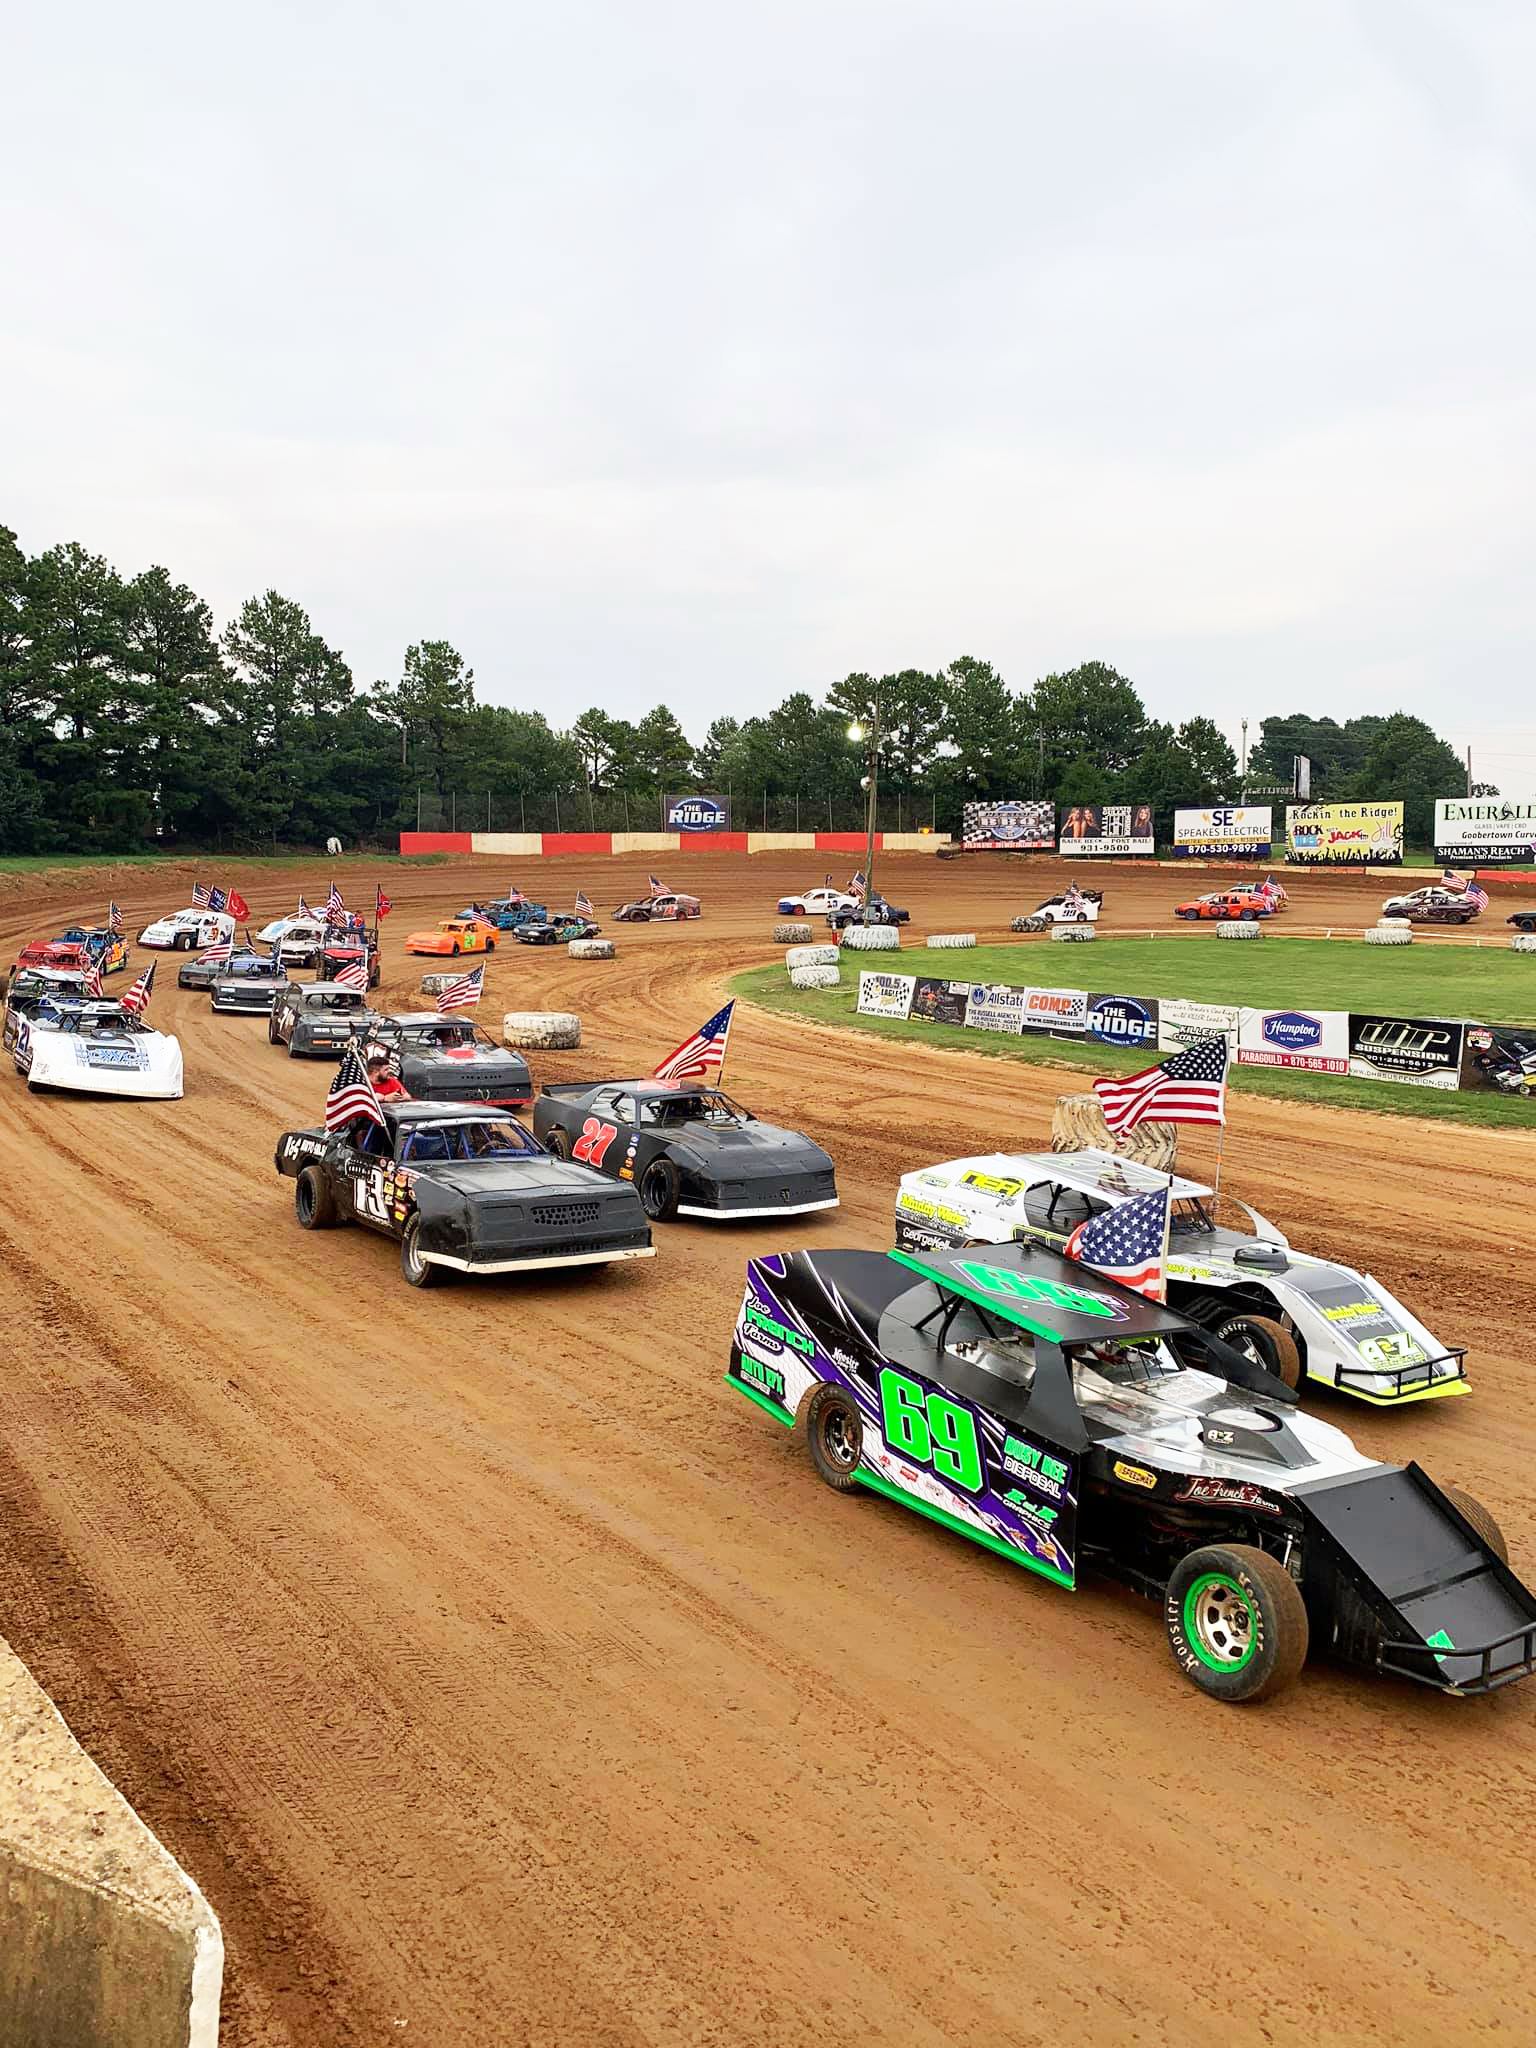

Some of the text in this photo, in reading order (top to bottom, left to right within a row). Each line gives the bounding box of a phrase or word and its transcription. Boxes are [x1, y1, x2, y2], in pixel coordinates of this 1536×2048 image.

[669, 809, 726, 823] RIDGE
[1212, 810, 1233, 826] SE
[1340, 809, 1357, 818] the
[1361, 807, 1398, 818] Ridge!
[1178, 826, 1269, 837] SPEAKES ELECTRIC
[1294, 825, 1323, 836] ROCK
[1328, 830, 1361, 843] JACK
[1462, 831, 1512, 839] Goobertown
[1080, 844, 1129, 852] 931-9500
[1188, 844, 1257, 853] 870-530-9892
[1438, 847, 1488, 856] SHAMAN'S
[1029, 995, 1071, 1011] COMP
[1103, 1007, 1126, 1017] THE
[1085, 1011, 1157, 1038] RIDGE
[1180, 1026, 1216, 1036] KILLER
[1265, 1021, 1319, 1037] Hampton
[1174, 1034, 1211, 1043] COATIN
[1355, 1044, 1449, 1061] SUSPENSION
[1240, 1052, 1344, 1071] PARAGOULD 870-565-1010
[572, 1117, 617, 1168] 27
[355, 1165, 389, 1221] 13
[749, 1296, 769, 1313] Joe
[744, 1323, 782, 1351] Farms
[746, 1307, 815, 1357] FRENCH
[1217, 1323, 1248, 1339] oosier
[879, 1367, 983, 1493] 69
[1004, 1435, 1068, 1485] BUSY BEE
[1004, 1456, 1061, 1499] DISPOSAL
[1183, 1478, 1280, 1511] Joe French Farms
[1003, 1500, 1051, 1529] GRAPHICS
[1169, 1596, 1199, 1672] Hoosier
